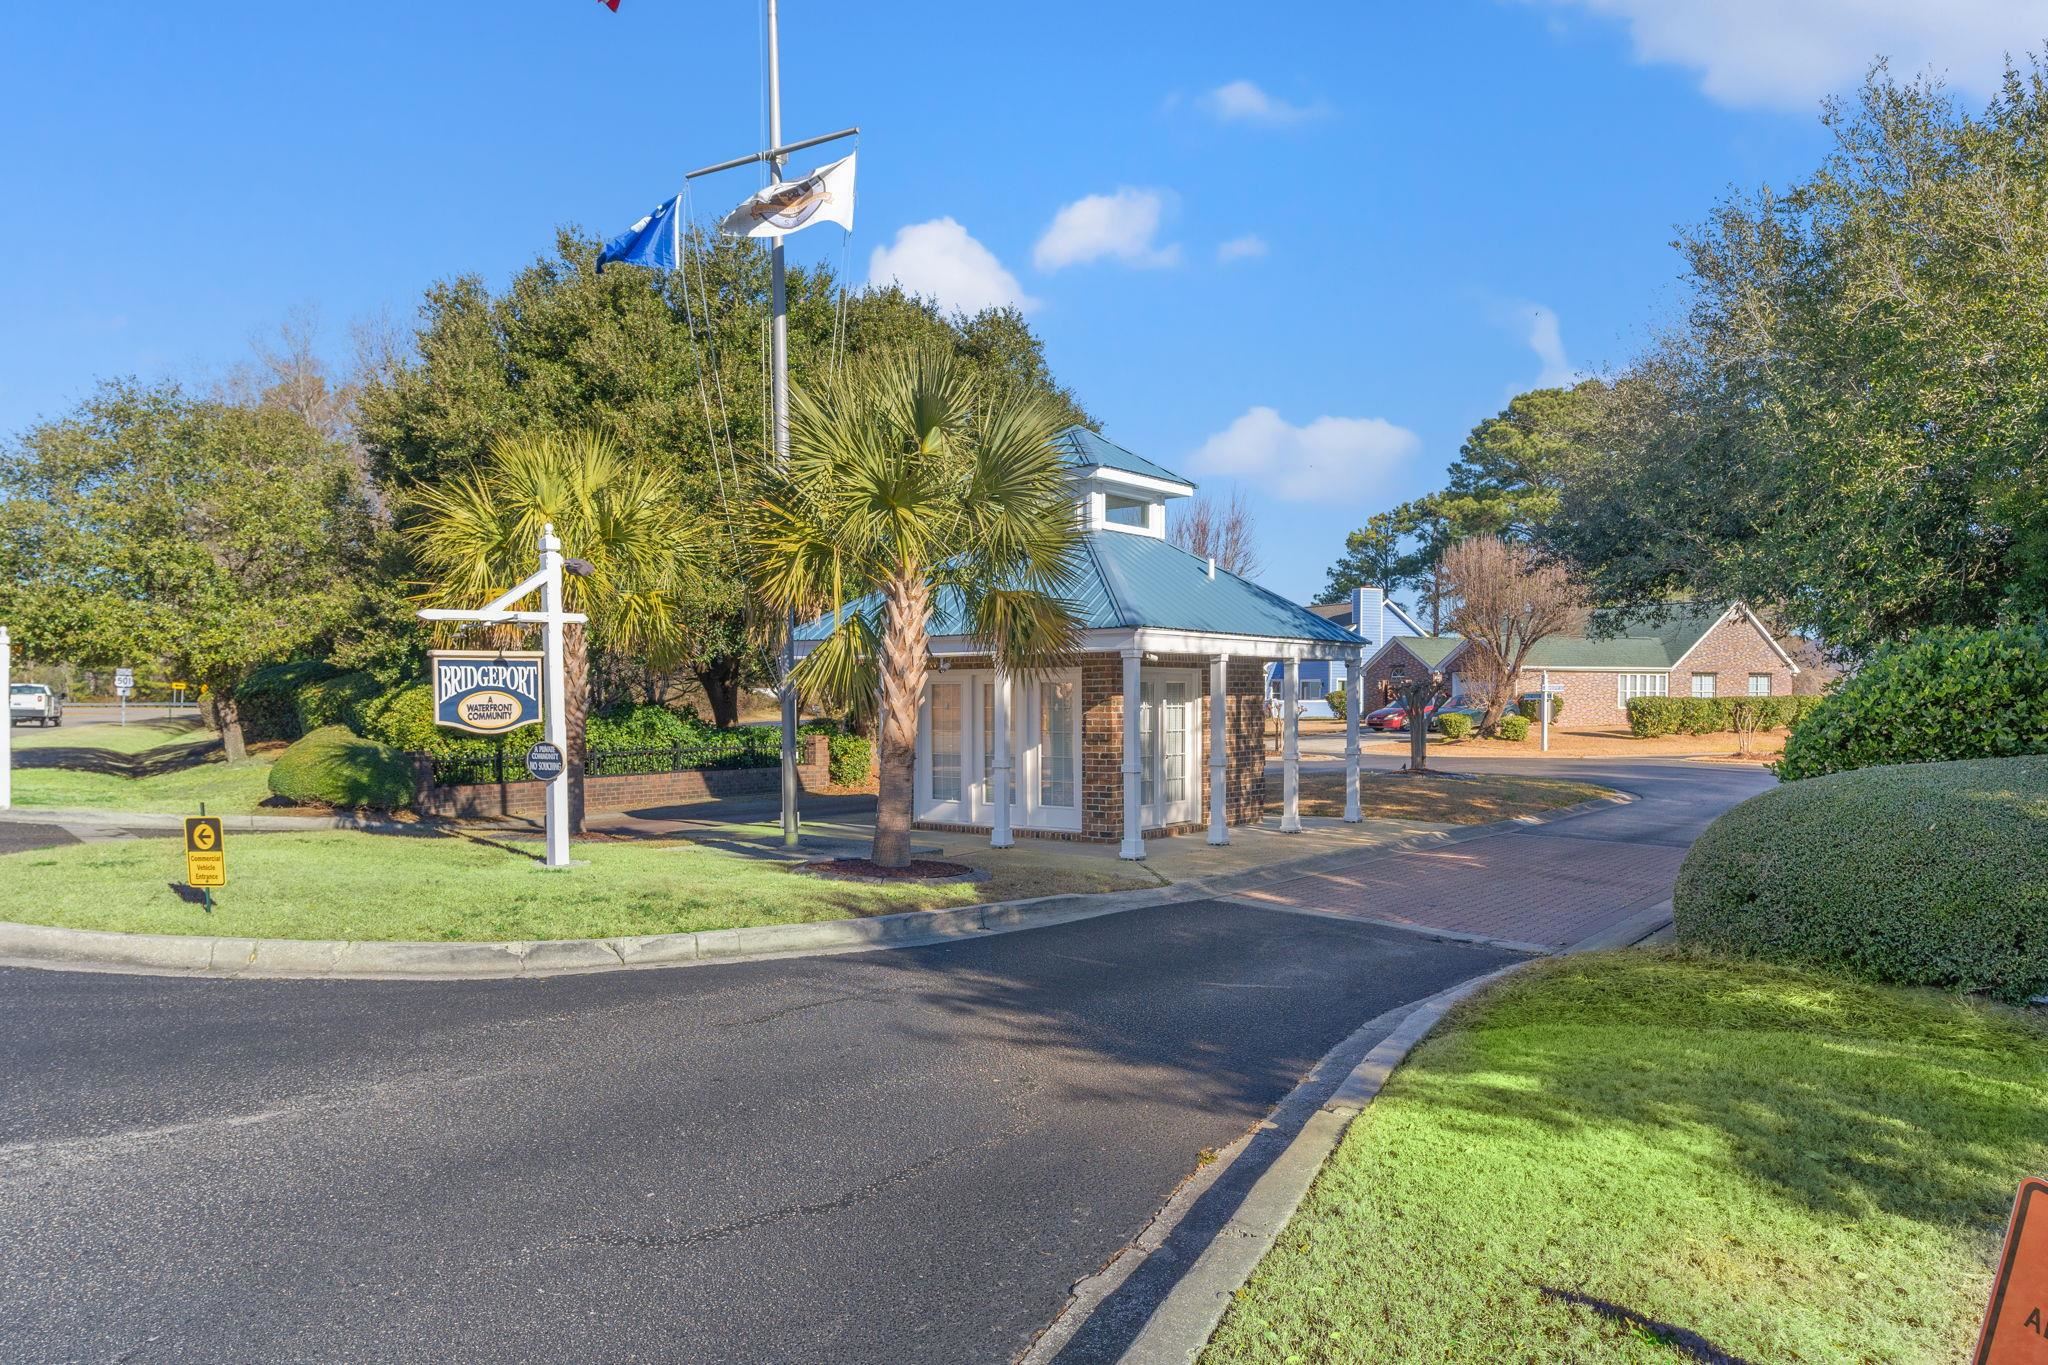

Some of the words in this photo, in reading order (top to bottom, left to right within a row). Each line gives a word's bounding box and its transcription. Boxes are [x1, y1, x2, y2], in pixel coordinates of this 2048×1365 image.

[117, 677, 131, 685] 501
[439, 665, 537, 703] BRIDGEPORT
[466, 704, 512, 712] WATERFRONT
[467, 712, 512, 720] COMMUNITY
